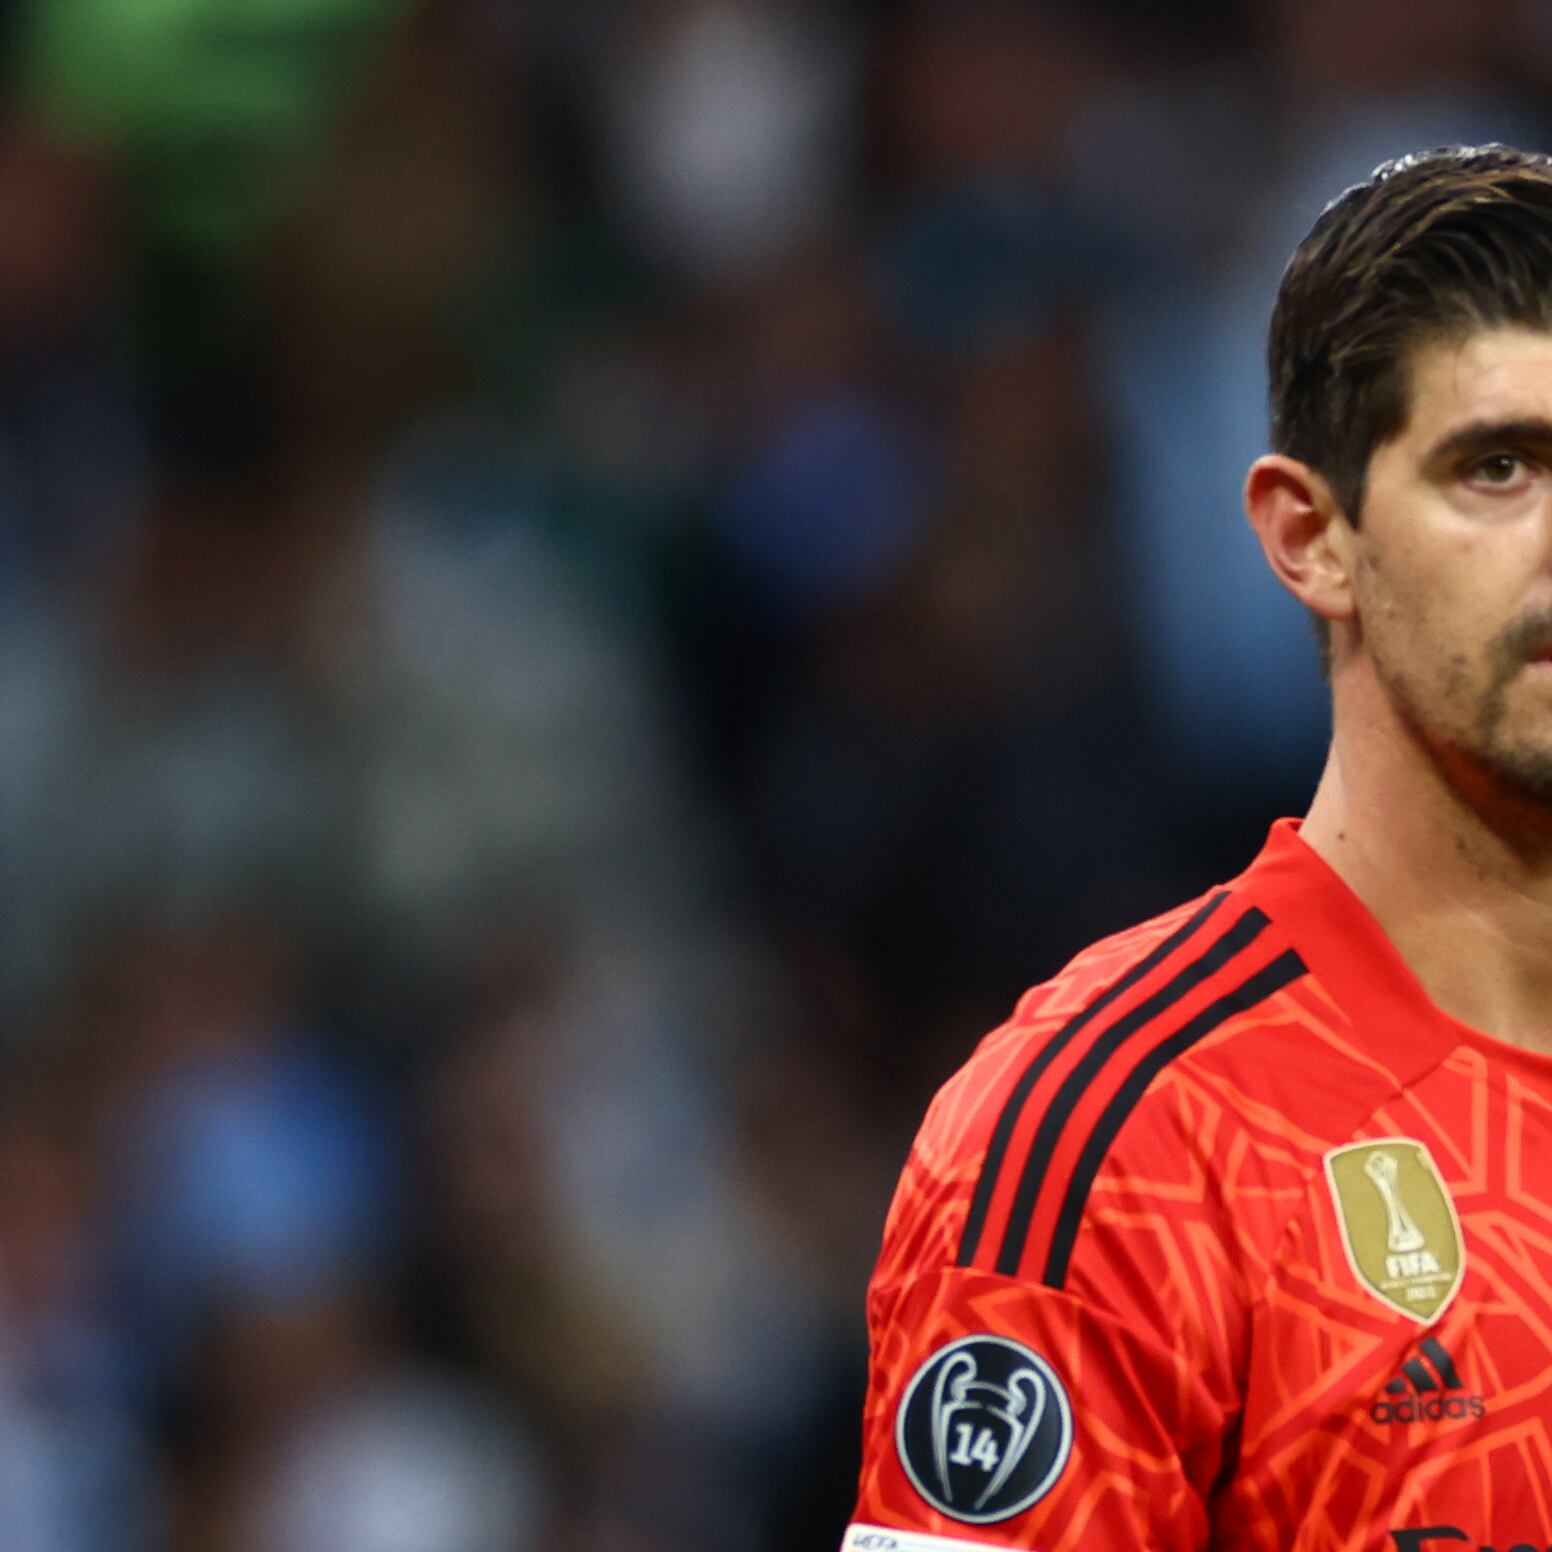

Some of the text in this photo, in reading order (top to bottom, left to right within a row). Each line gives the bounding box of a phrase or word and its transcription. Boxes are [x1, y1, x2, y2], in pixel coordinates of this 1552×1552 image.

[1385, 1250, 1440, 1279] FIFA
[1370, 1393, 1486, 1426] adidas
[950, 1423, 999, 1472] 14
